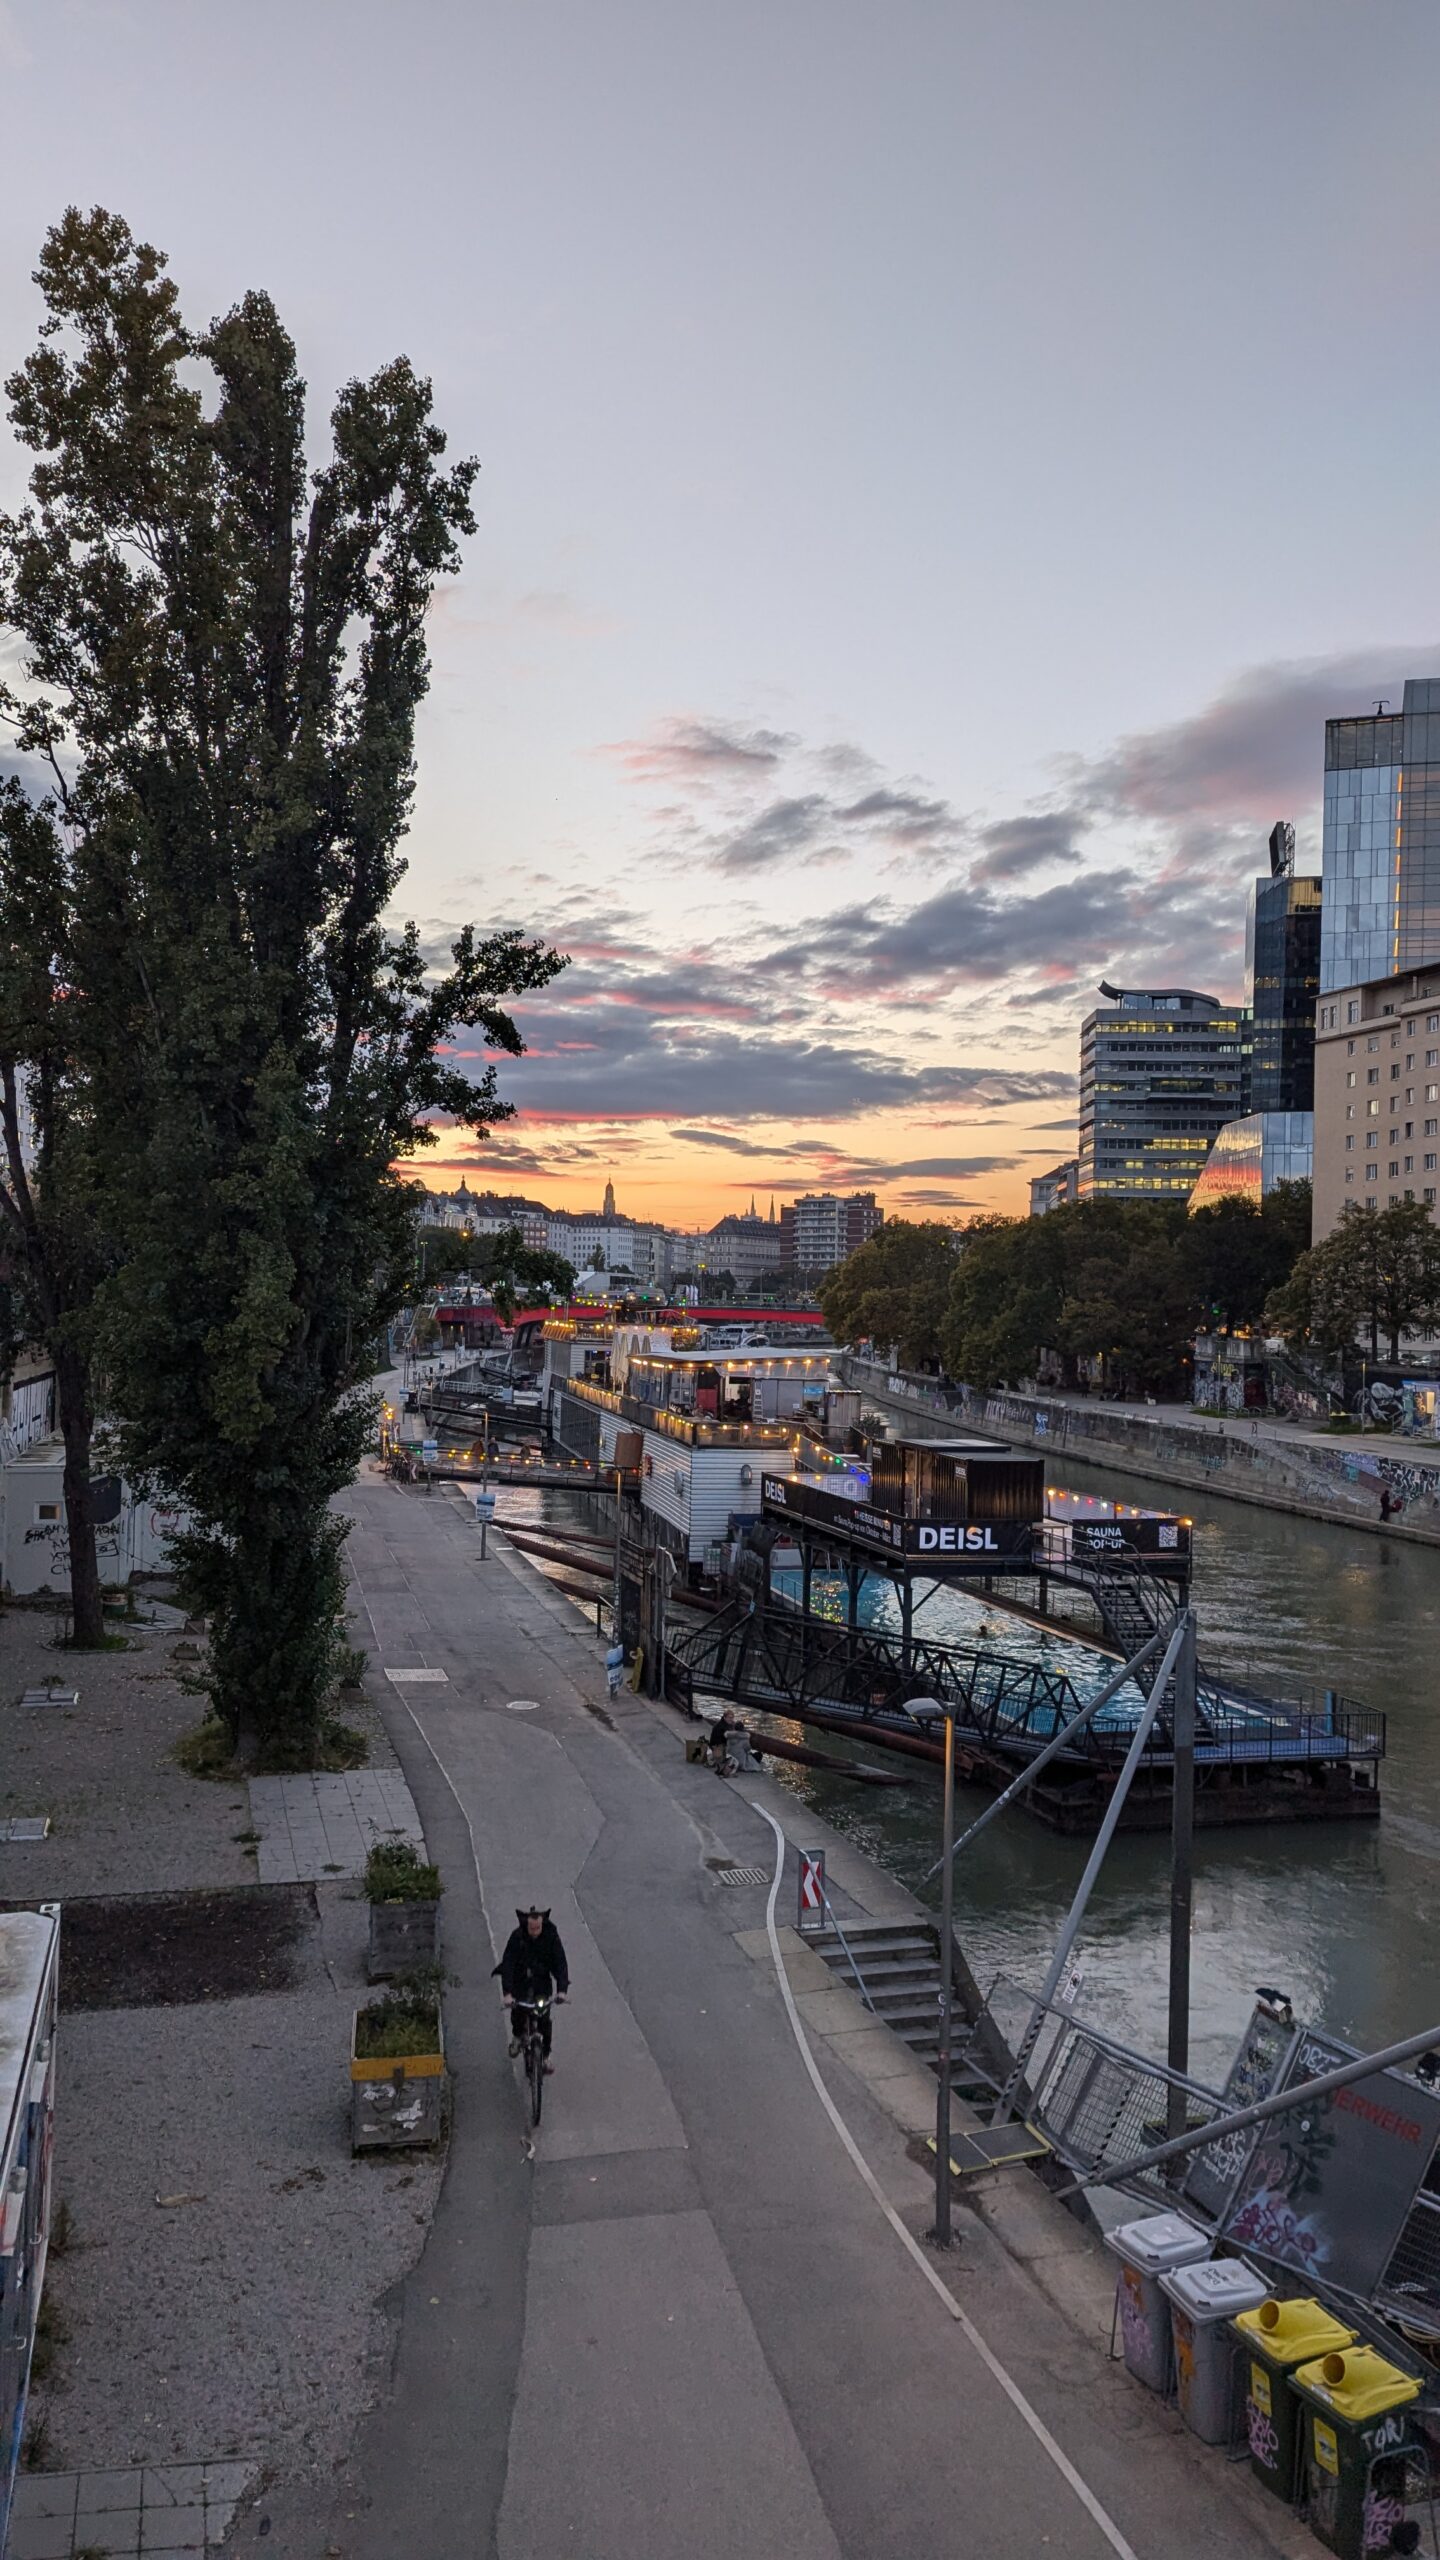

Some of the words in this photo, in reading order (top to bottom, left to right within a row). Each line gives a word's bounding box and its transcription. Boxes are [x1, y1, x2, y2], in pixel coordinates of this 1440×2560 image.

[765, 1480, 786, 1504] DEISL
[919, 1526, 999, 1550] DEISL
[1086, 1527, 1122, 1537] SAUNA
